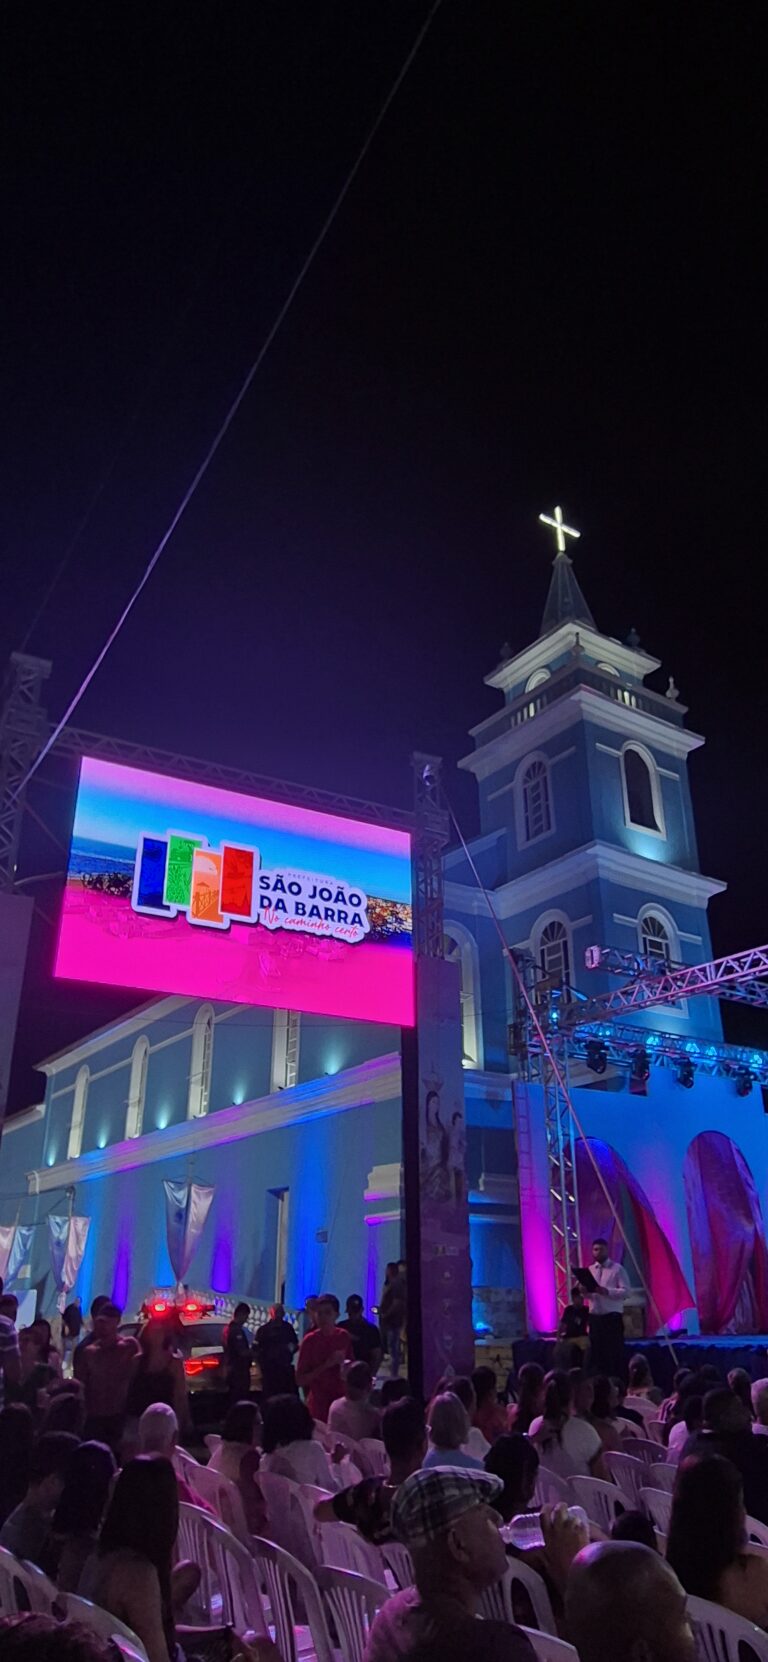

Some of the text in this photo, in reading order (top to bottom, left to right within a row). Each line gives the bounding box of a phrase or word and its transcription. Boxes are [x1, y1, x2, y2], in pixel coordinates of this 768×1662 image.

[259, 874, 362, 907] SÃO JOÃO
[288, 873, 333, 885] PREFEITURA
[259, 894, 364, 927] DA BARRA
[264, 906, 359, 938] No caminho certo
